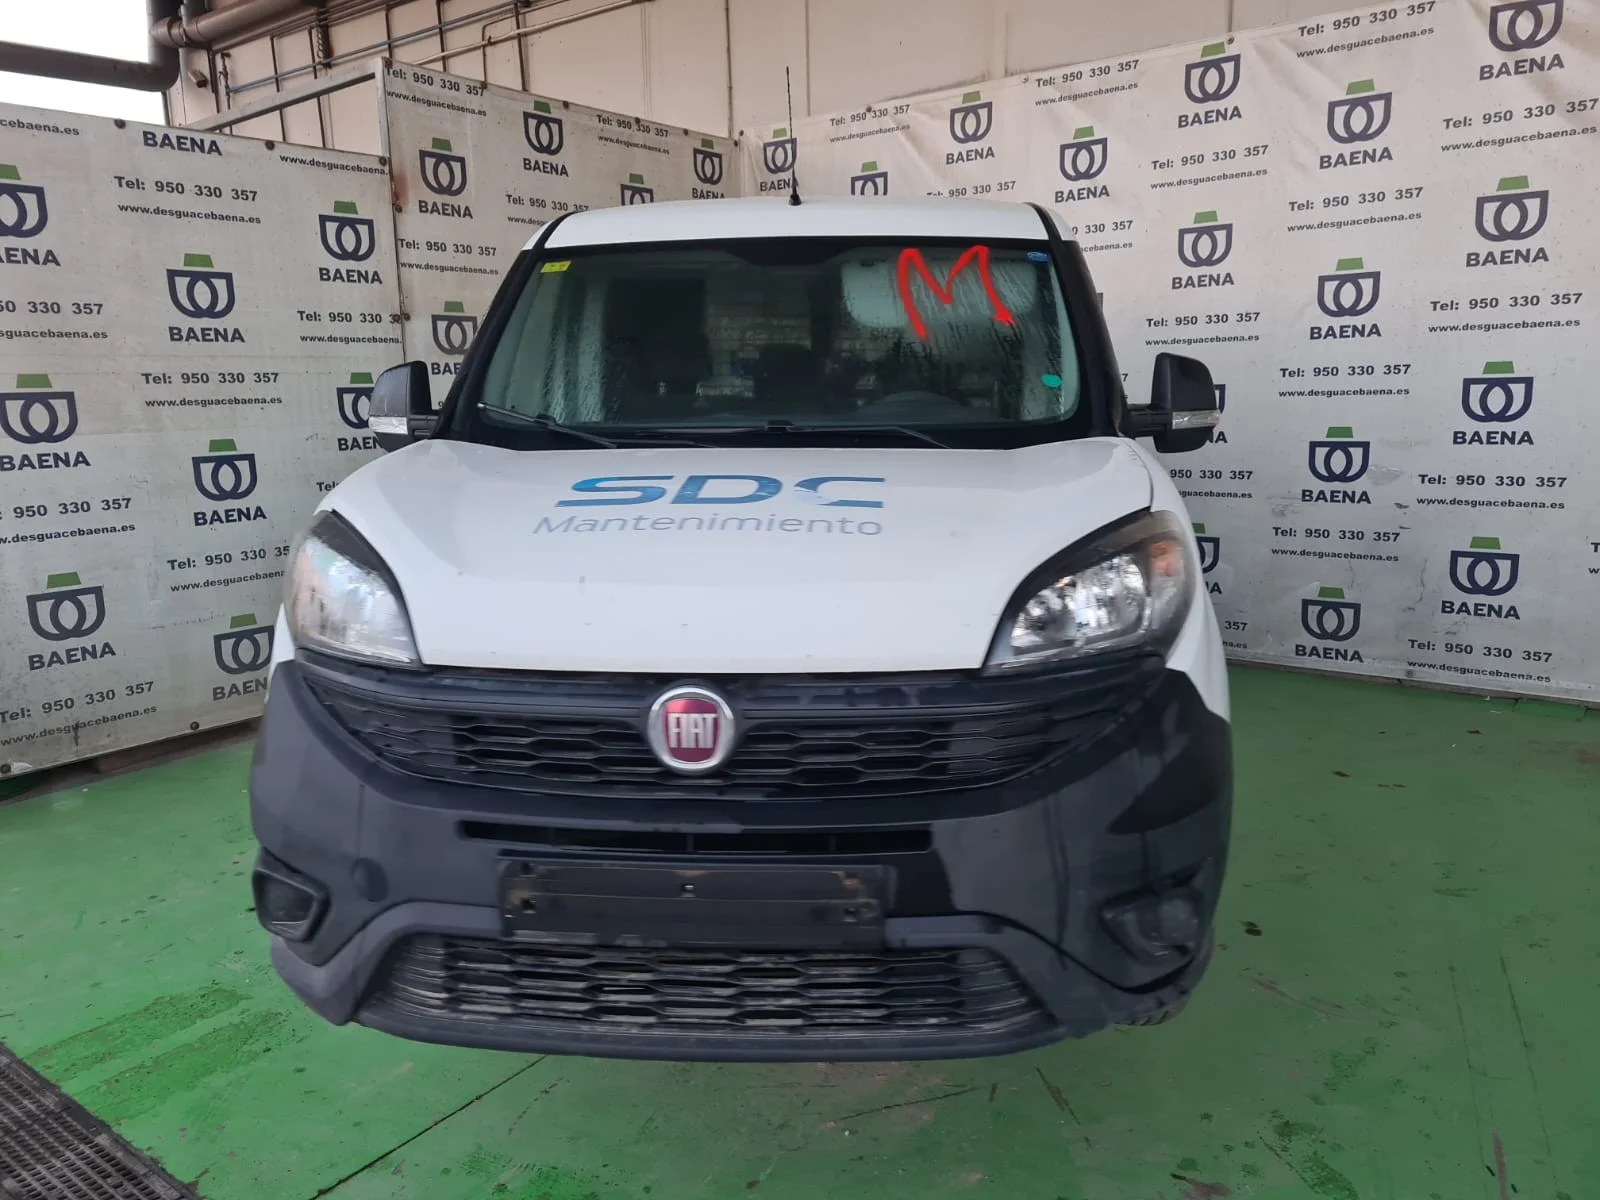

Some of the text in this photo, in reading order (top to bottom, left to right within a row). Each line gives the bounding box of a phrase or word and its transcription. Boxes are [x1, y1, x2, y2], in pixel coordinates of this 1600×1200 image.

[1299, 0, 1436, 36] Tel: 950 330 357
[1297, 28, 1433, 57] www.desguacebaena.es
[1036, 60, 1139, 87] Tel: 950 330 357
[1480, 54, 1564, 80] BAENA
[413, 72, 433, 86] 950
[440, 79, 460, 91] 330
[386, 89, 487, 117] www.desguacebaena.es
[1036, 83, 1138, 105] www.desguacebaena.es
[830, 105, 909, 127] Tel: 950 330 357
[1178, 106, 1242, 128] BAENA
[1443, 98, 1599, 129] Tel: 950 330 357
[596, 114, 669, 138] Tel: 950 330 357
[143, 131, 222, 156] BAENA
[1441, 127, 1596, 151] www.desguacebaena.es
[946, 147, 995, 165] BAENA
[1152, 145, 1268, 170] Tel: 950 330 357
[1320, 147, 1393, 169] BAENA
[523, 158, 568, 177] BAENA
[114, 176, 257, 201] Tel: 950 330 357
[973, 185, 991, 194] 330
[997, 181, 1016, 191] 357
[1151, 170, 1267, 189] www.desguacebaena.es
[506, 194, 524, 205] Tel:
[530, 198, 546, 208] 950
[551, 201, 569, 211] 330
[1055, 185, 1110, 203] BAENA
[1289, 187, 1423, 211] Tel: 950 330 357
[118, 205, 261, 223] www.desguacebaena.es
[419, 200, 473, 219] BAENA
[1085, 224, 1105, 233] 330
[1112, 220, 1133, 231] 357
[1288, 213, 1421, 231] www.desguacebaena.es
[398, 238, 496, 256] Tel: 950 330 357
[1466, 248, 1549, 267] BAENA
[319, 267, 382, 284] BAENA
[400, 261, 499, 275] www.desguacebaena.es
[1172, 273, 1234, 289] BAENA
[897, 245, 1016, 343] M
[1430, 293, 1582, 311] Tel: 950 330 357
[27, 301, 60, 314] 330
[72, 303, 103, 315] 357
[297, 311, 321, 321] Tel:
[329, 312, 352, 322] 950
[360, 313, 382, 323] 330
[1146, 312, 1260, 327] Tel: 950 330 357
[1429, 320, 1580, 332] www.desguacebaena.es
[168, 327, 245, 342] BAENA
[1146, 336, 1259, 345] www.desguacebaena.es
[1310, 324, 1381, 340] BAENA
[141, 373, 279, 384] Tel: 950 330 357
[1280, 364, 1411, 377] Tel: 950 330 357
[145, 397, 282, 407] www.desguacebaena.es
[1279, 388, 1409, 398] www.desguacebaena.es
[1453, 431, 1534, 445] BAENA
[0, 451, 91, 471] BAENA
[1170, 468, 1253, 480] 950 330 357
[1418, 474, 1567, 487] Tel: 950 330 357
[1302, 489, 1371, 504] BAENA
[1417, 498, 1564, 509] www.desguacebaena.es
[13, 505, 47, 518] 950
[59, 501, 90, 514] 330
[101, 498, 131, 510] 357
[194, 506, 267, 526] BAENA
[532, 512, 883, 537] Mantenimiento
[1272, 527, 1400, 542] Tel: 950 330 357
[167, 546, 289, 570] Tel: 950 330 35
[1272, 549, 1398, 561] www.desguacebaena.es
[1442, 600, 1520, 620] BAENA
[1225, 621, 1247, 630] 357
[28, 642, 116, 670] BAENA
[1296, 645, 1363, 662] BAENA
[1408, 639, 1552, 662] Tel: 950 330 357
[1407, 661, 1550, 682] www.desguacebaena.es
[213, 678, 266, 700] BAEN
[0, 681, 153, 723] Tel: 950 330 357
[667, 712, 718, 749] FIAT
